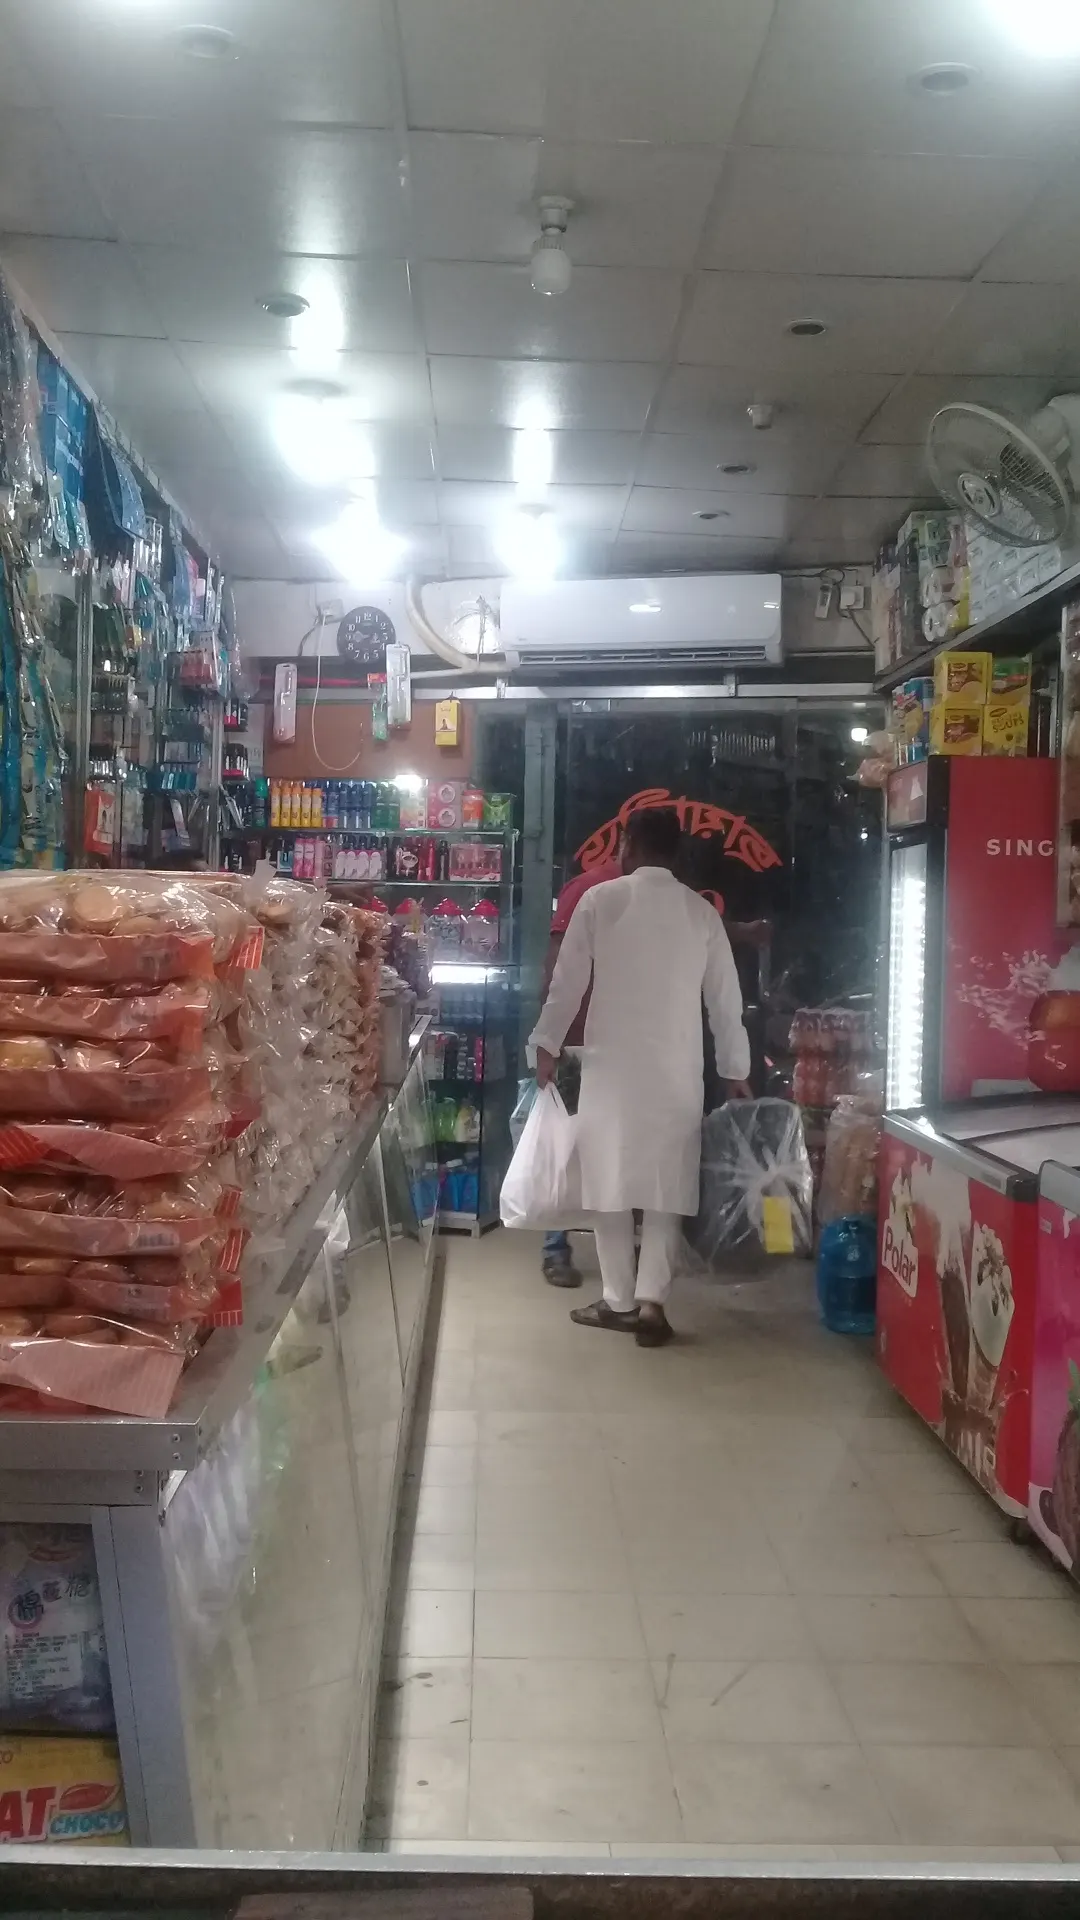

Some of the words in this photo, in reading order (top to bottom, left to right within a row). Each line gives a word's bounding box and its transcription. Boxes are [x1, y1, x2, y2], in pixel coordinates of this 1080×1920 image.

[986, 838, 1055, 857] SING
[884, 1225, 916, 1287] Polar
[50, 1810, 125, 1835] CHOCO
